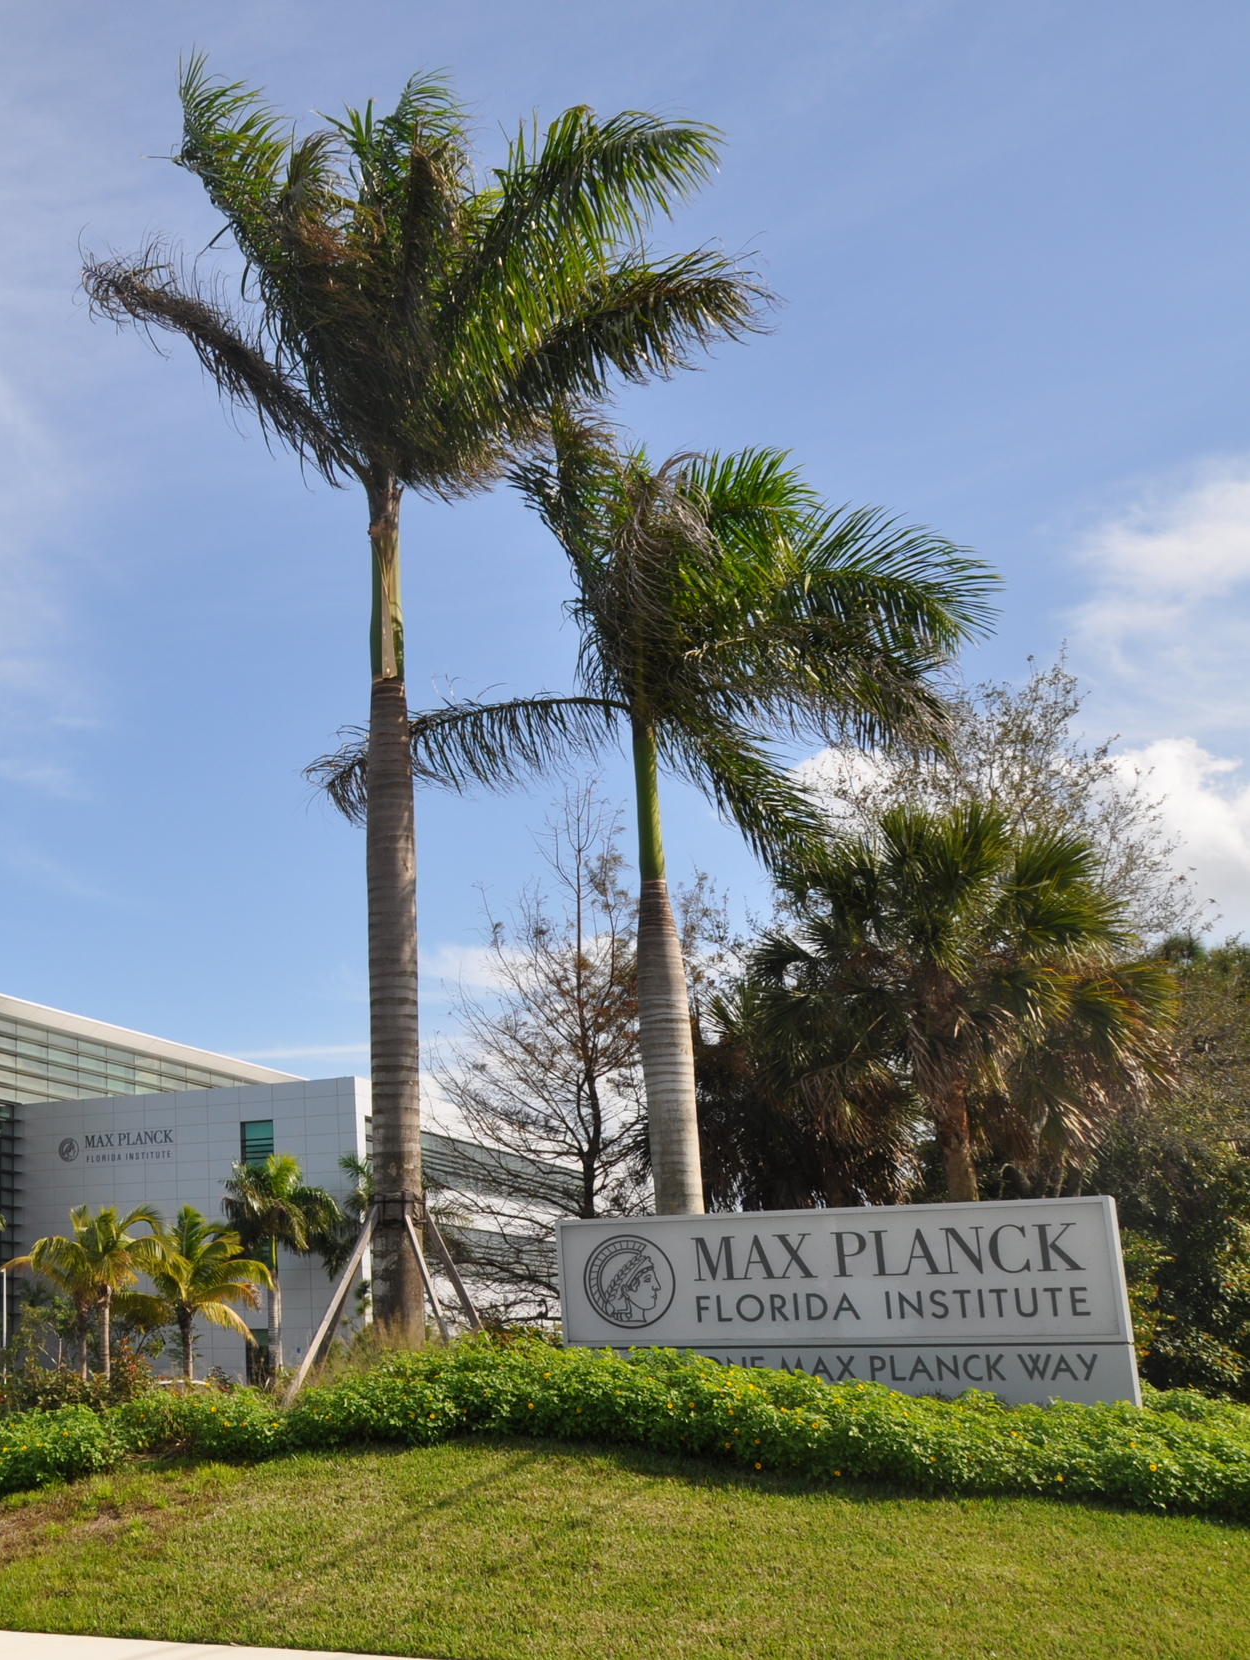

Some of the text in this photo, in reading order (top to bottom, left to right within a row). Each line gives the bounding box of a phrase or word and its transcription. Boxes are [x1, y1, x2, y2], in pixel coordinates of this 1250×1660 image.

[84, 1129, 174, 1149] MAX PLANCK
[86, 1150, 172, 1163] FLORIDA INSTITUTE
[691, 1222, 1087, 1282] MAX PLANCK
[695, 1286, 1092, 1323] FLORIDA INSTITUTE
[868, 1353, 1008, 1382] PLANCK
[1017, 1353, 1098, 1381] WAY
